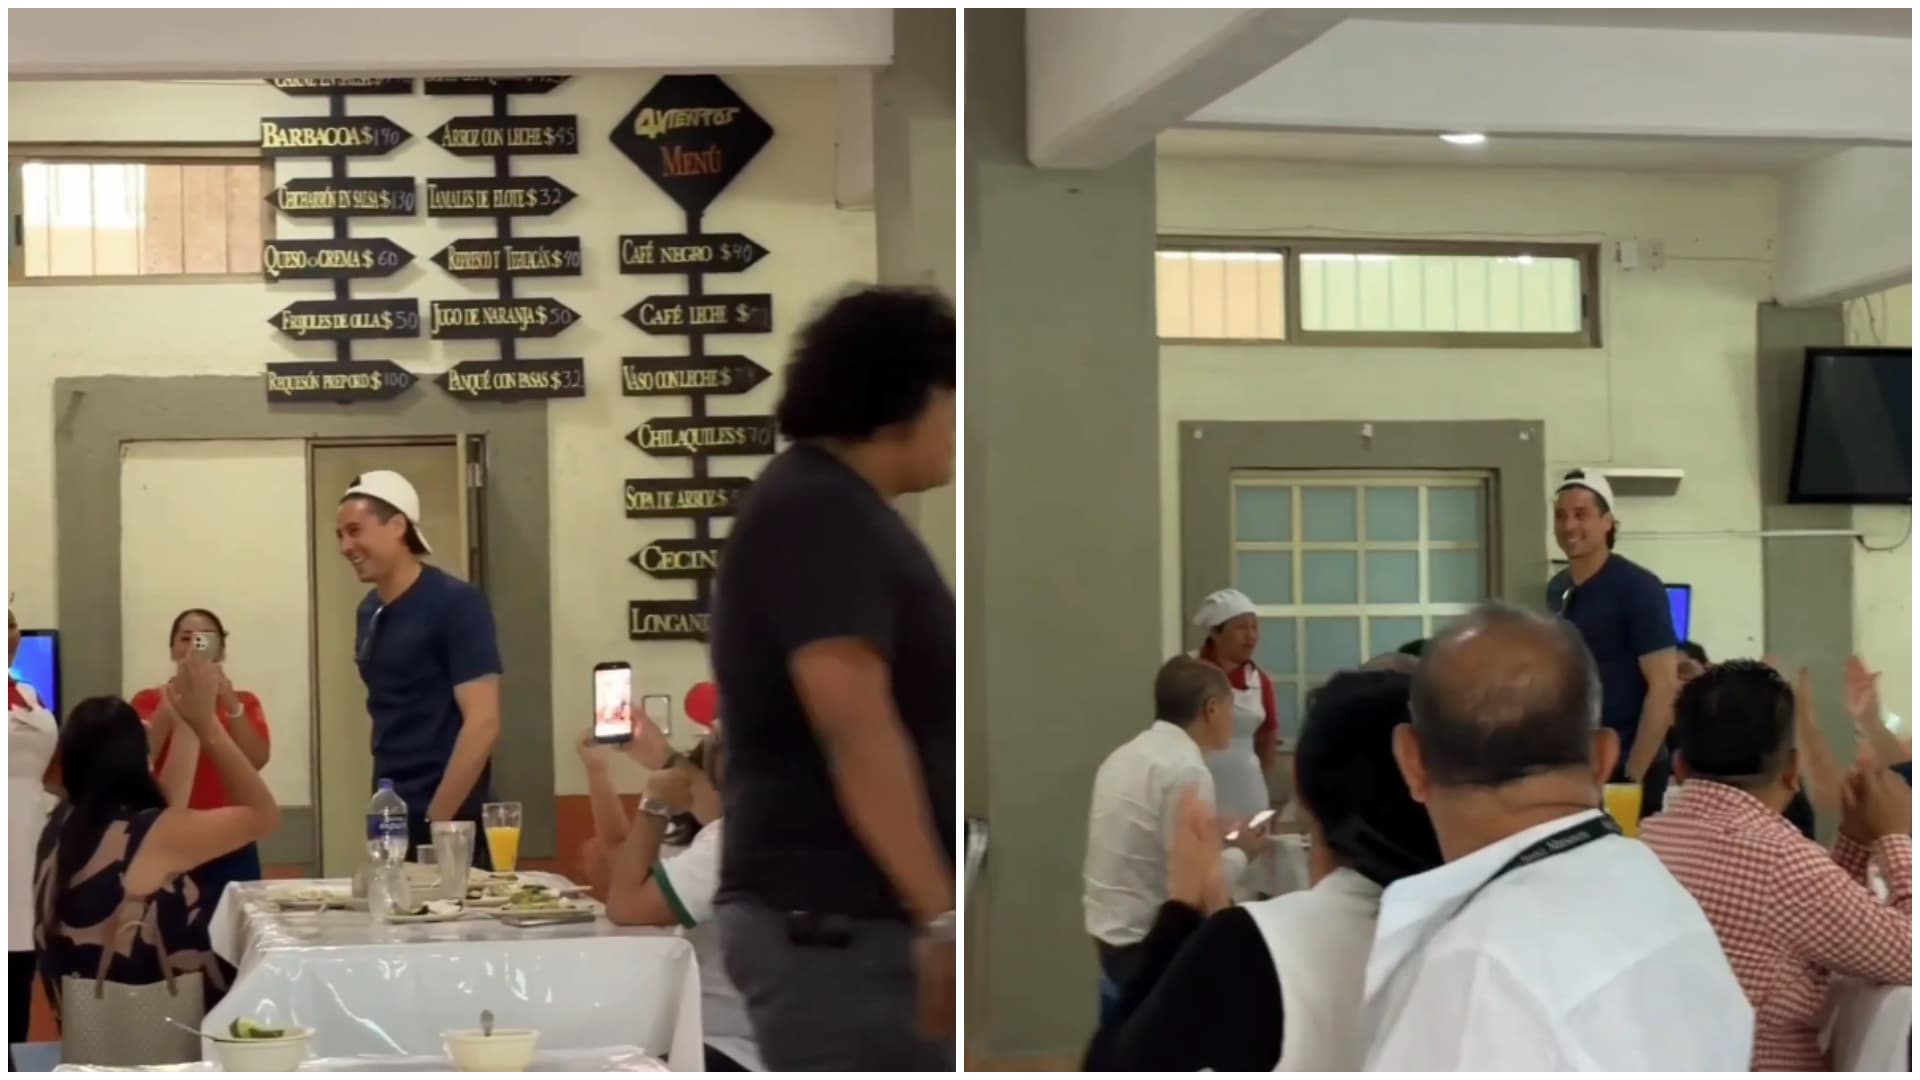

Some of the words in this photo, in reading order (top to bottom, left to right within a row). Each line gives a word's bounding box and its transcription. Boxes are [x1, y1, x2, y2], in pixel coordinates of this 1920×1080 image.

[261, 122, 360, 148] BARBACOA
[442, 123, 480, 147] ARROZ
[481, 128, 504, 146] CON
[507, 128, 543, 146] LECHE
[660, 144, 722, 177] MENÚ
[427, 184, 474, 209] TAMALES
[475, 189, 490, 208] DE
[492, 189, 525, 208] ELOTE
[264, 245, 306, 277] QUESO
[318, 249, 361, 268] CREMA
[622, 239, 655, 264] CAFÉ
[660, 245, 713, 264] NEGRO
[282, 310, 331, 335] FRIJOLES
[333, 314, 349, 329] DE
[350, 313, 380, 329] OLLA
[431, 303, 462, 334] JUGO
[464, 308, 480, 325] DE
[482, 307, 535, 331] NARANJA
[639, 303, 684, 326] CAFÉ
[688, 305, 728, 325] LECHE
[268, 370, 320, 396] REQUESÓN
[448, 369, 492, 396] PANQUÉ
[493, 372, 517, 389] CON
[518, 372, 550, 389] PASAS
[623, 365, 653, 391] VASO
[655, 370, 679, 389] CON
[679, 369, 719, 388] LECHE
[637, 424, 735, 453] CHILAQUILES
[625, 485, 655, 511] SOPA
[656, 491, 675, 510] DE
[676, 489, 716, 508] ARROZ
[639, 546, 719, 571] CECIN
[631, 608, 712, 634] LONGANI
